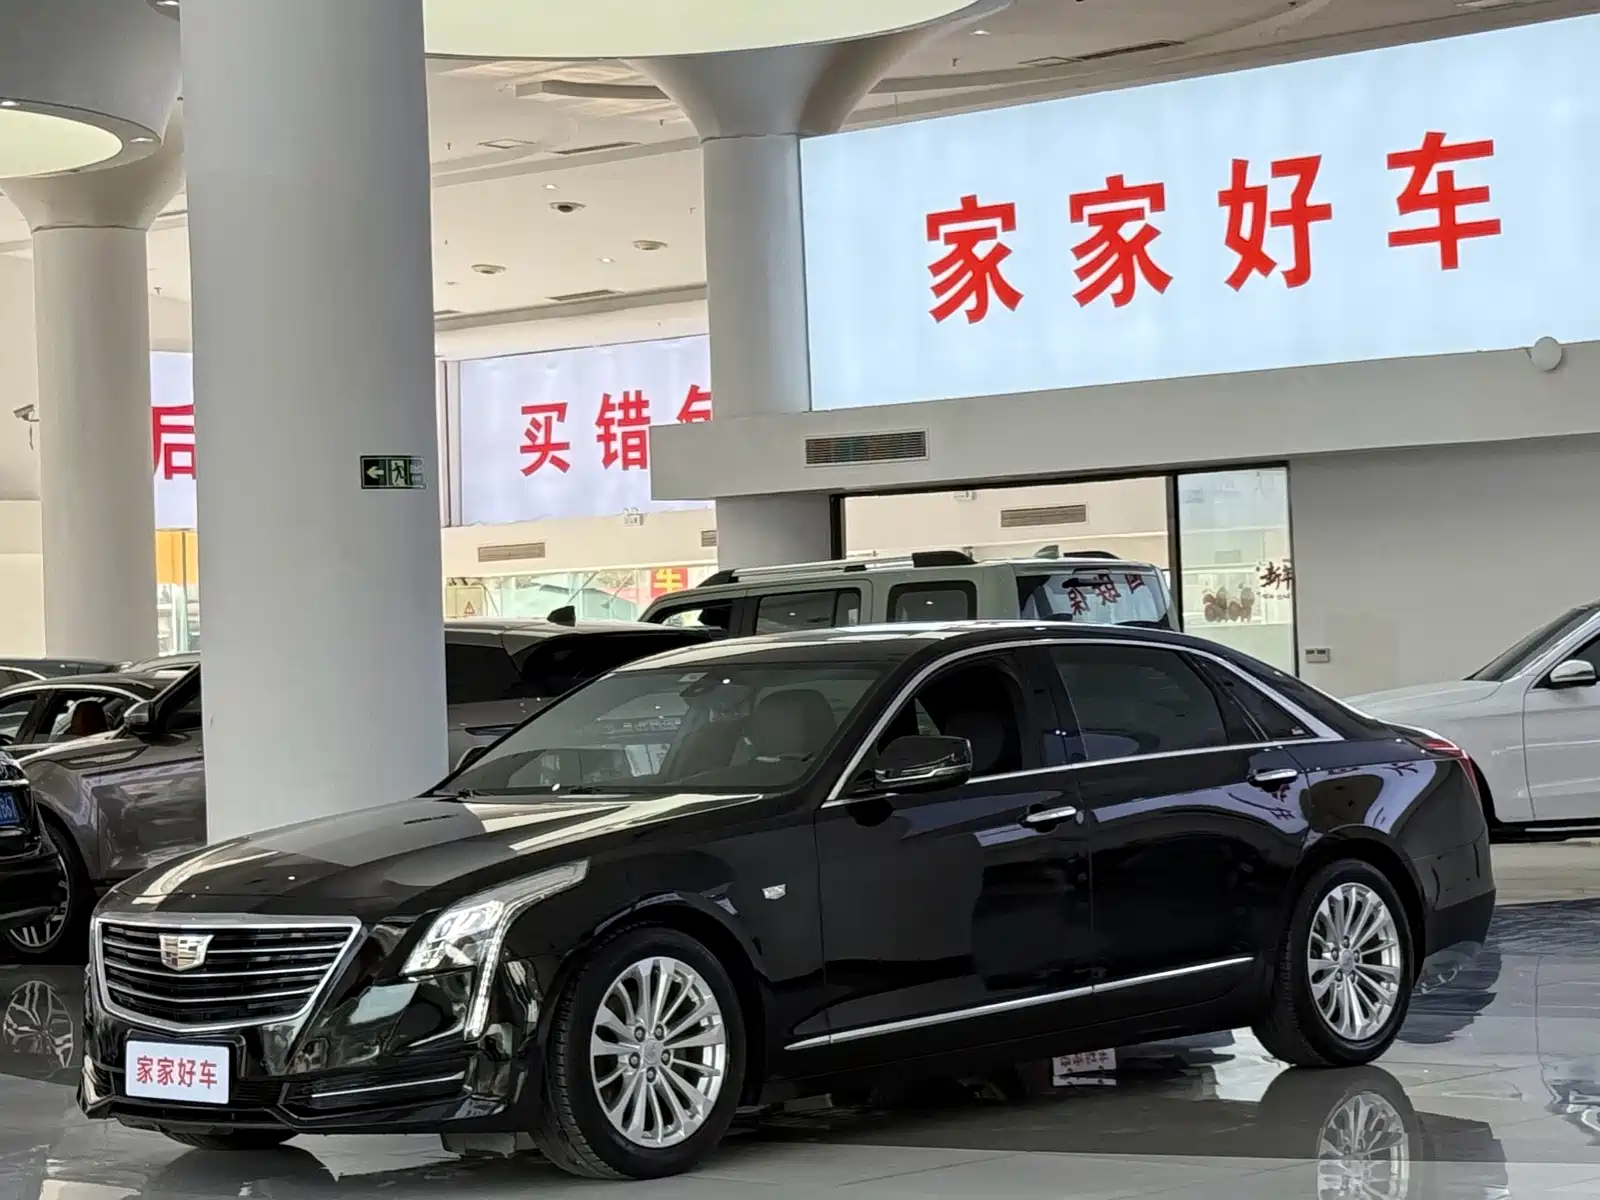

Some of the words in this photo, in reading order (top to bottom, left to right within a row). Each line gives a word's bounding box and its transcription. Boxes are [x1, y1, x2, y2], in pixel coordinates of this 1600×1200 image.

[925, 131, 1502, 324] 家家好车
[151, 404, 197, 480] 后
[136, 1055, 218, 1089] 家家好车
